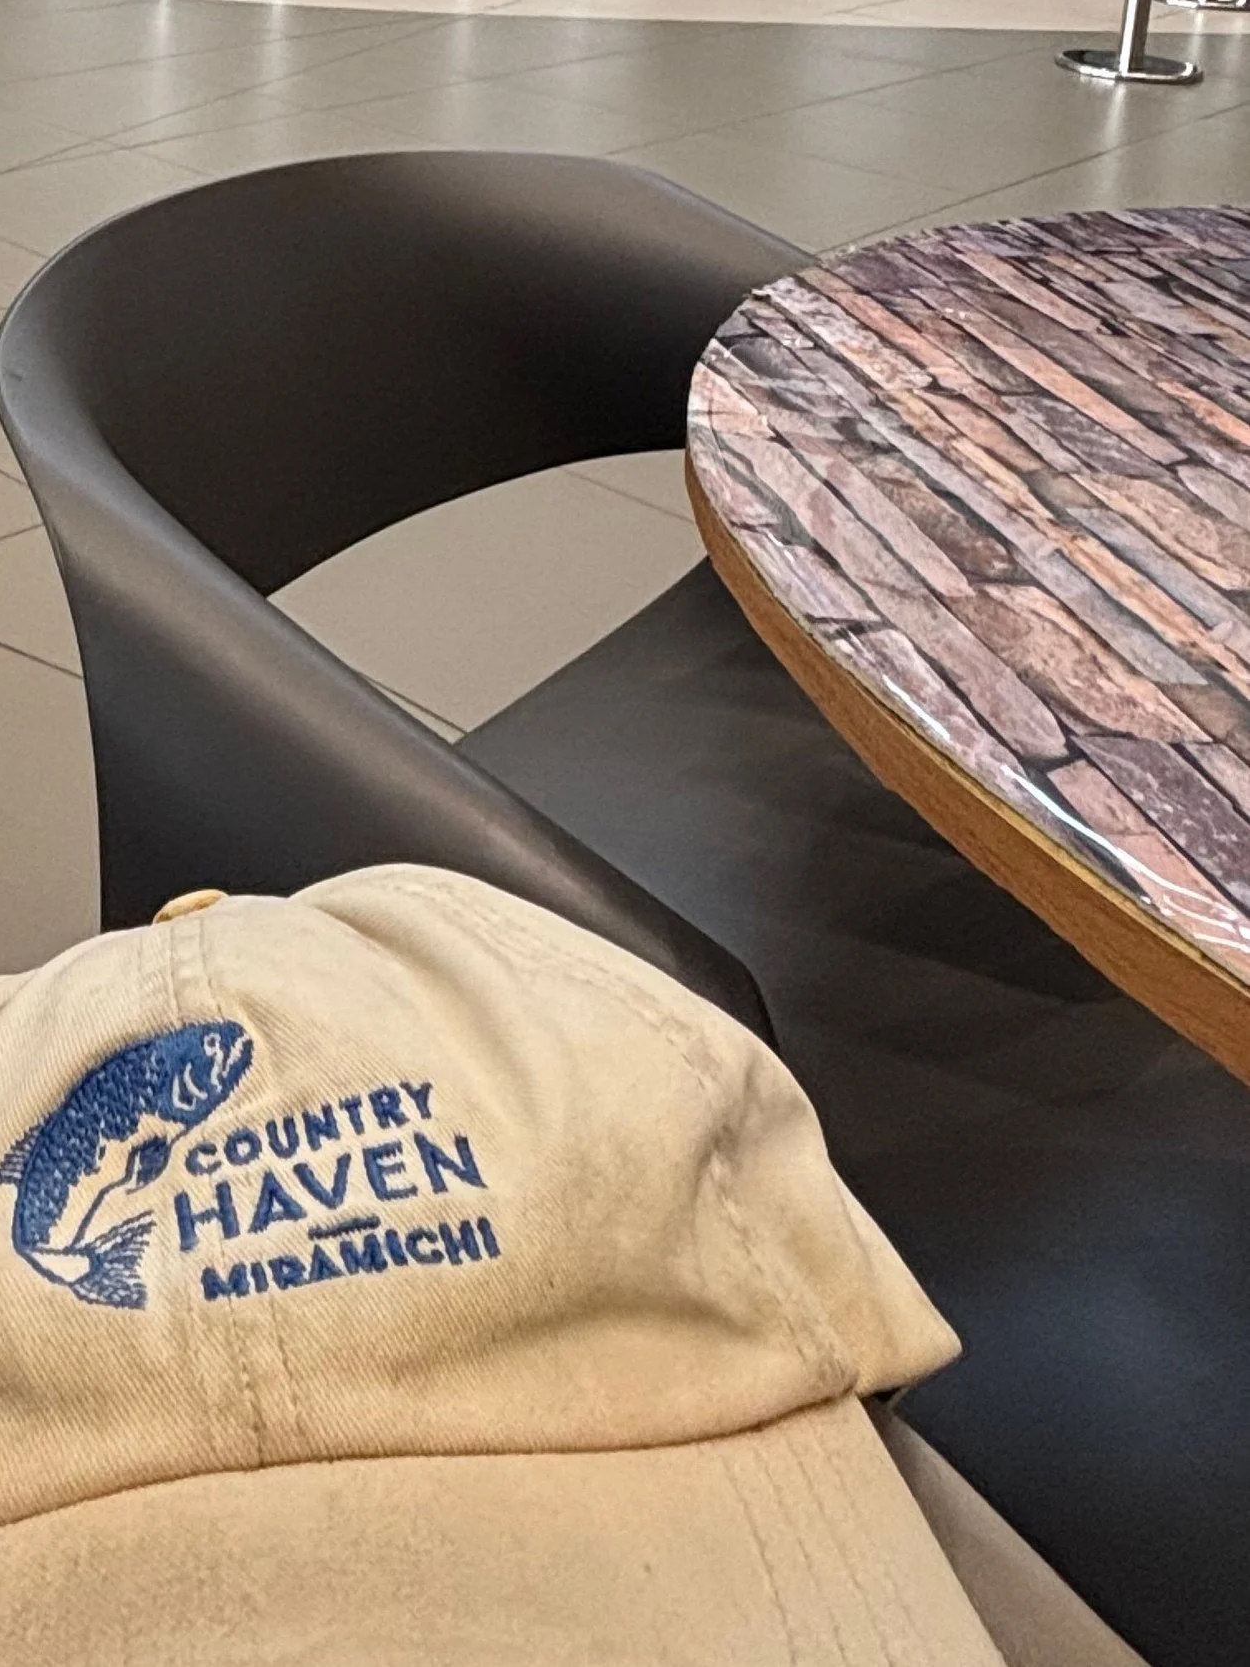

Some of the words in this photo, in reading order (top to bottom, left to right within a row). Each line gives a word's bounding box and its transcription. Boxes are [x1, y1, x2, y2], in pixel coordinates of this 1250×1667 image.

[184, 1081, 434, 1176] COUNTRY
[173, 1133, 488, 1253] HAVEN
[201, 1216, 500, 1301] MIRAMICHI
